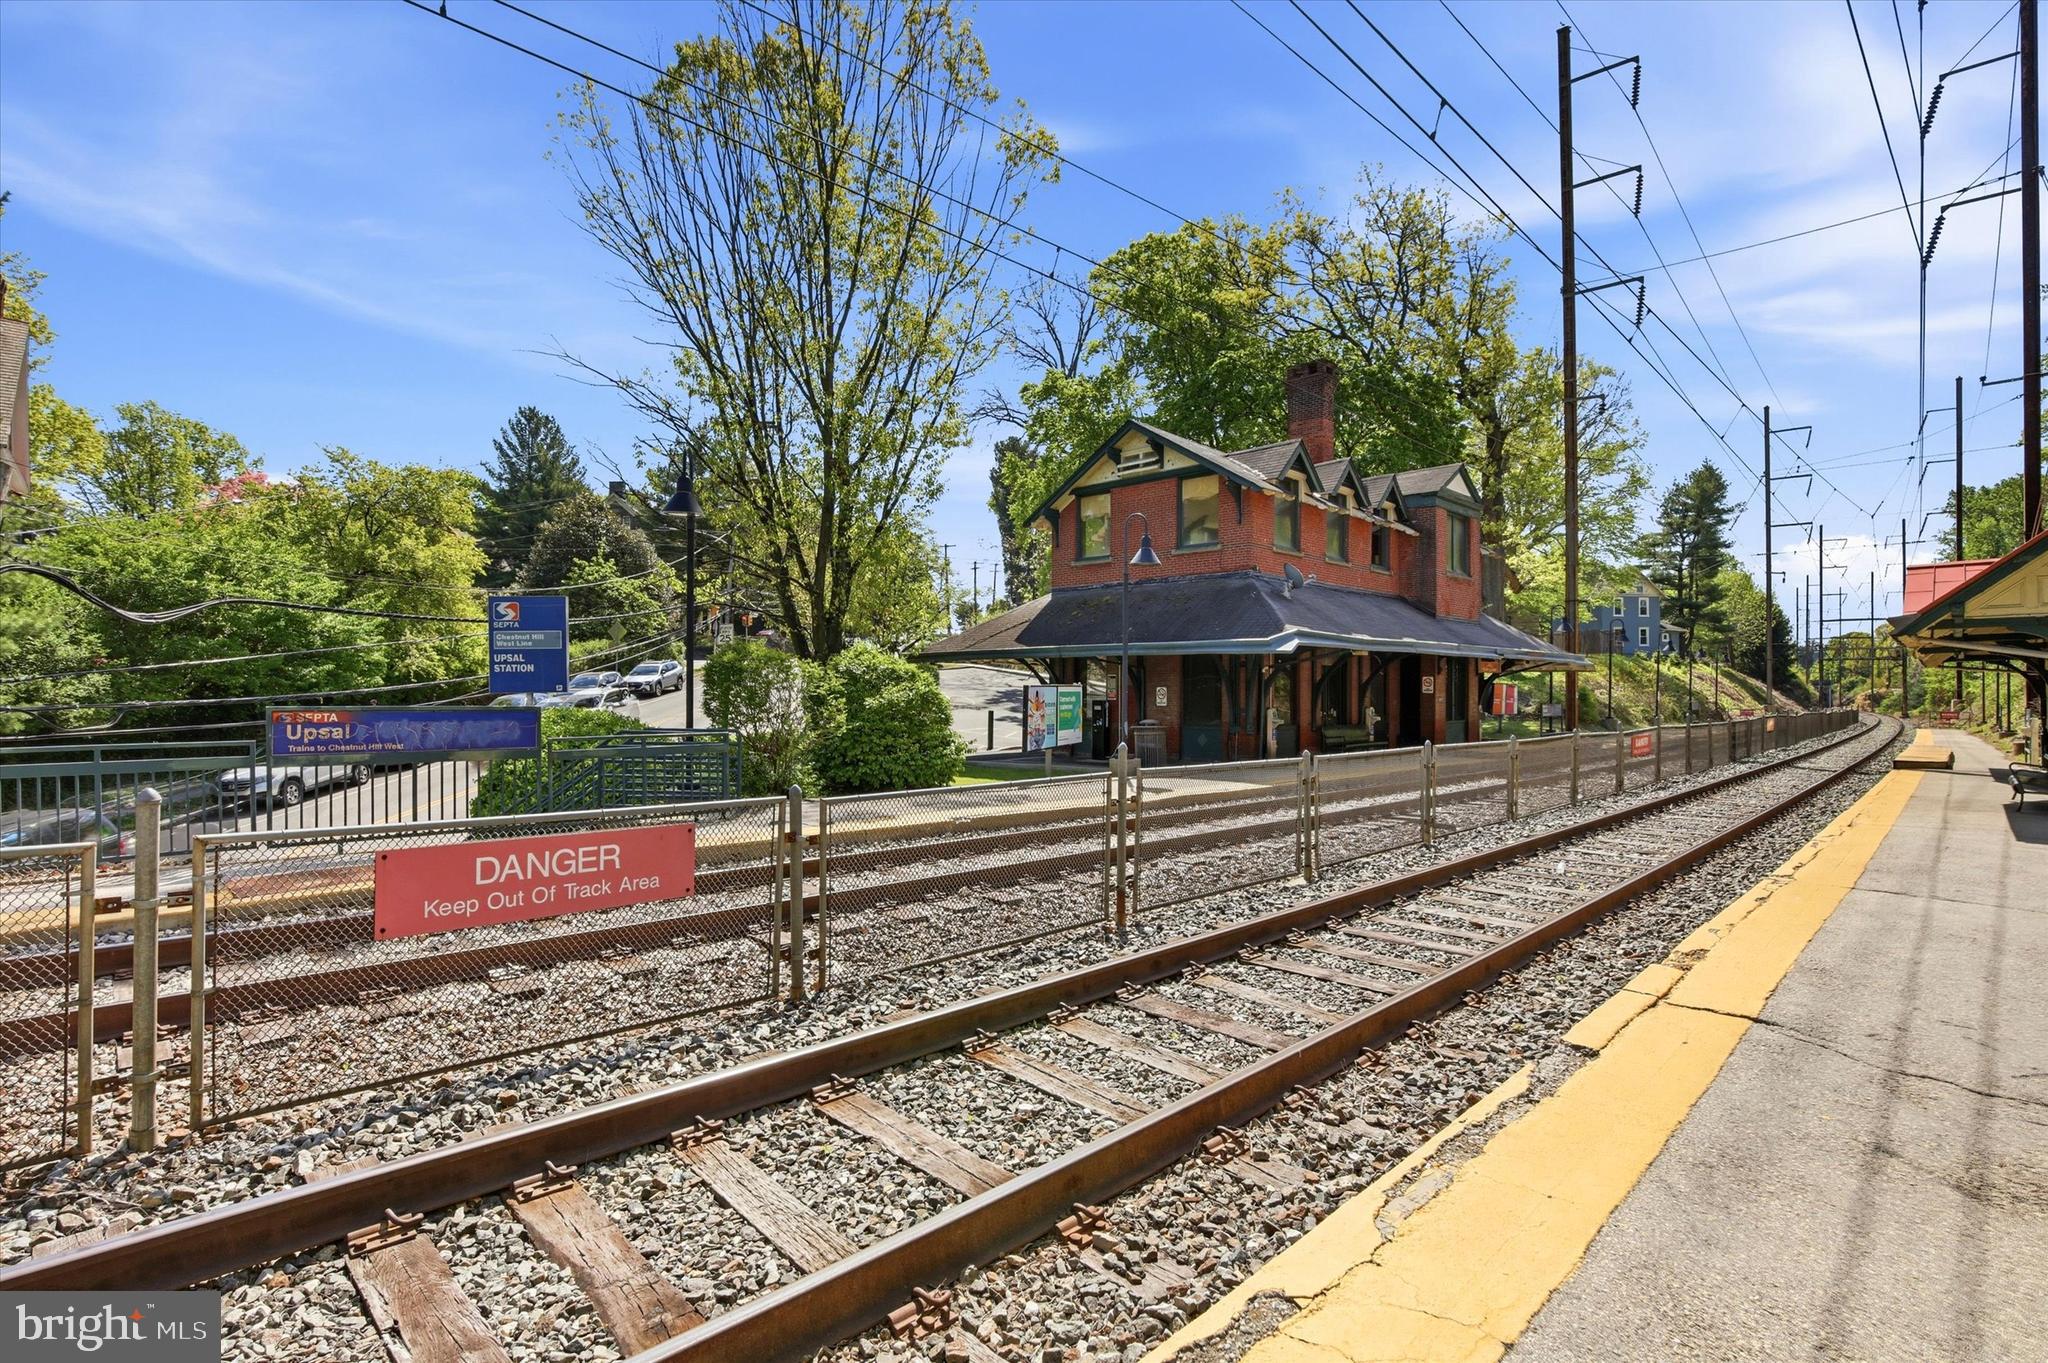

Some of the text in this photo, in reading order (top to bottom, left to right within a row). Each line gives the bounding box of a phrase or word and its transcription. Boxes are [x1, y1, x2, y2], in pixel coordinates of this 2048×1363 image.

[493, 621, 520, 629] SEPTA
[496, 633, 545, 641] Chestnut Hill
[493, 653, 526, 663] UPSAL
[493, 664, 535, 673] STATION
[296, 712, 339, 723] SEPTA
[286, 722, 351, 744] Upsal
[287, 744, 315, 753] Trains
[316, 744, 327, 752] to
[328, 743, 367, 752] Chestnut
[475, 844, 621, 886] DANGER
[424, 873, 661, 920] Keep Out Of Track Area
